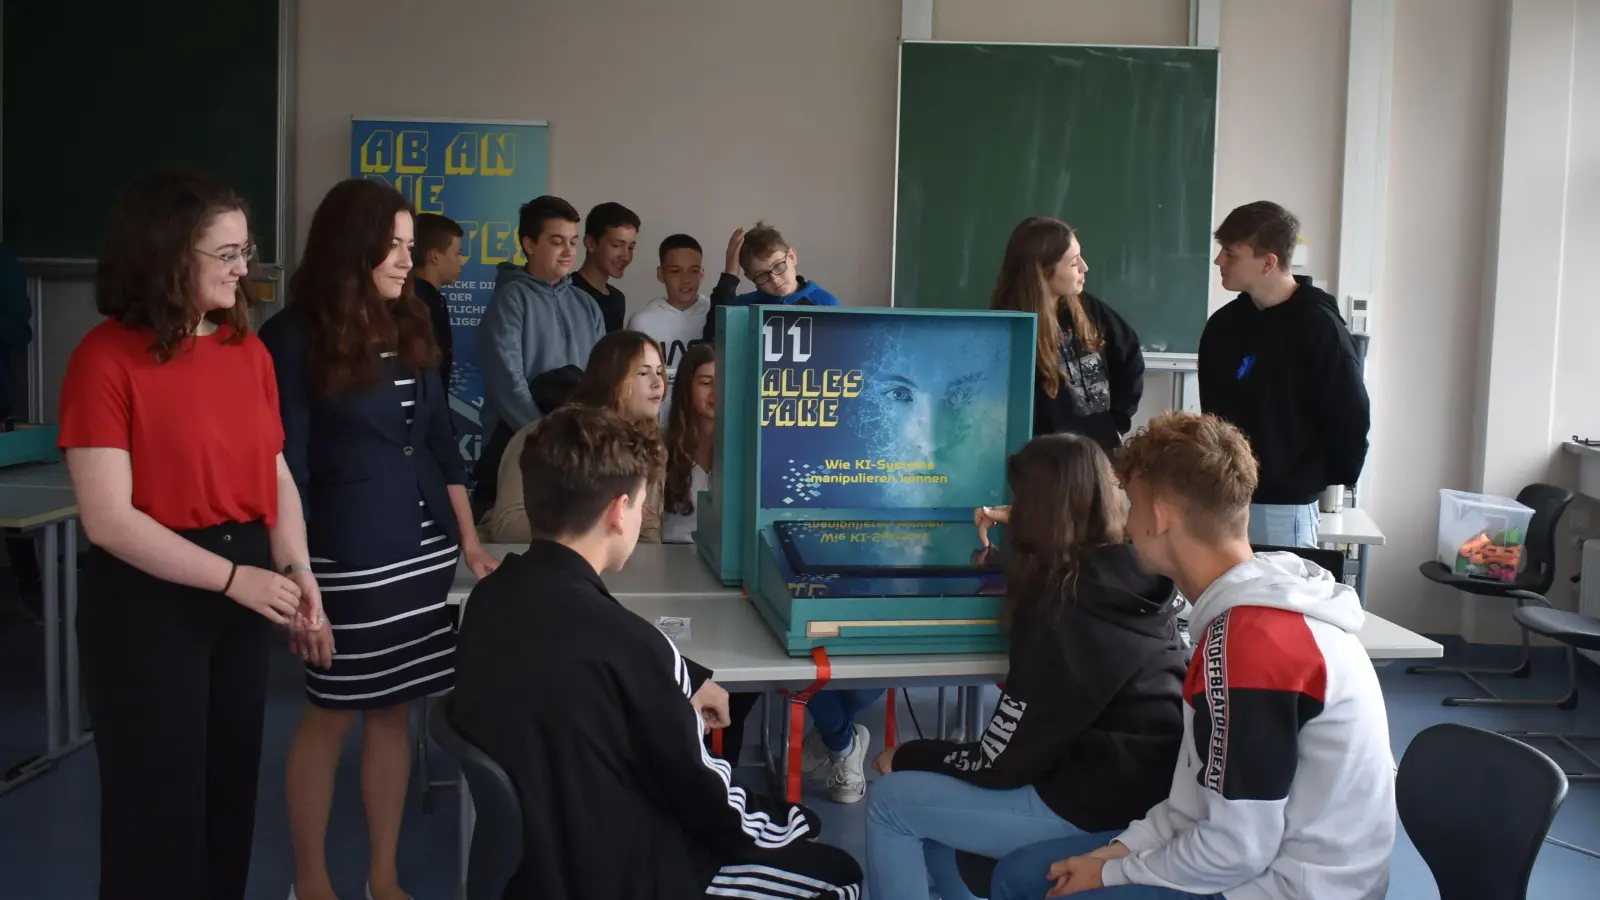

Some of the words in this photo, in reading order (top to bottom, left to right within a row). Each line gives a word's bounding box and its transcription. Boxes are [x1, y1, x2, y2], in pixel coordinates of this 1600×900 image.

[360, 129, 428, 174] AB
[445, 132, 516, 177] AN
[449, 293, 473, 302] DER
[762, 316, 813, 363] 11
[761, 367, 864, 398] ALLES
[760, 398, 839, 427] FAKE
[810, 473, 896, 485] manipulieren
[900, 472, 948, 484] können
[824, 459, 850, 470] Wie
